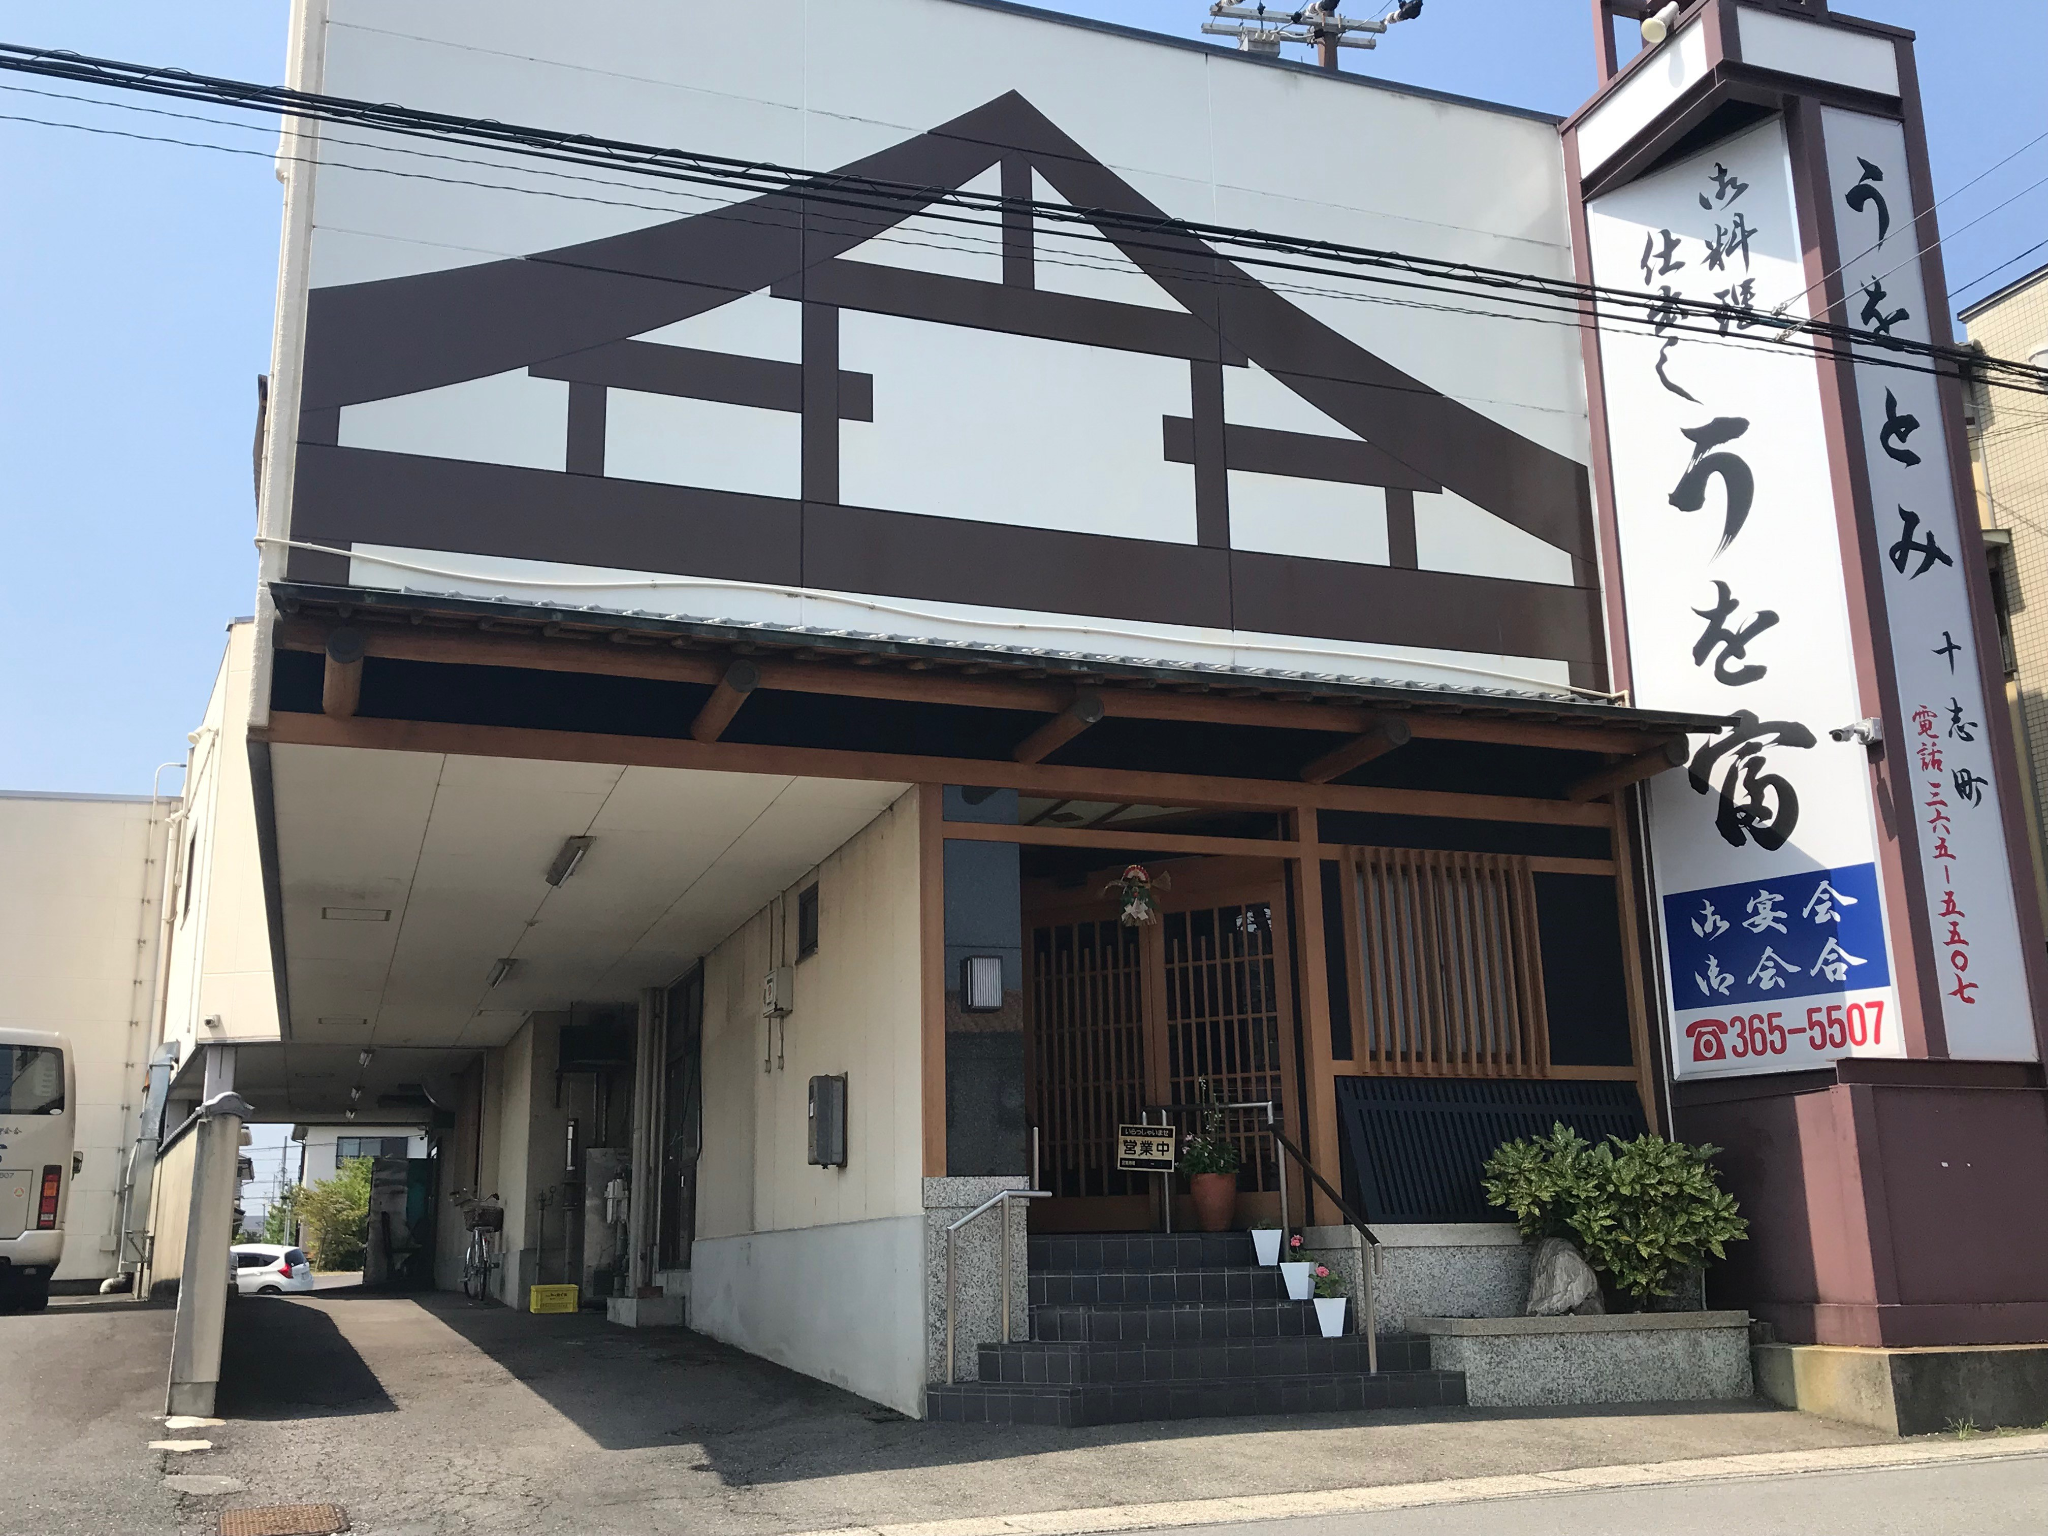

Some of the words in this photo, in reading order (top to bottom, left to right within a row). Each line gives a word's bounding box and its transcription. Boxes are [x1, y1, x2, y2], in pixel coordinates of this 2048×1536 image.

[1845, 155, 1954, 580] うをとみ
[1931, 630, 1989, 809] 十志町
[1690, 880, 1859, 942] 御宴会
[1694, 936, 1868, 997] 御会合
[1729, 1000, 1885, 1058] 365-5507
[1123, 1139, 1170, 1157] 営業中
[1124, 1127, 1169, 1137] いらっしゃいませ
